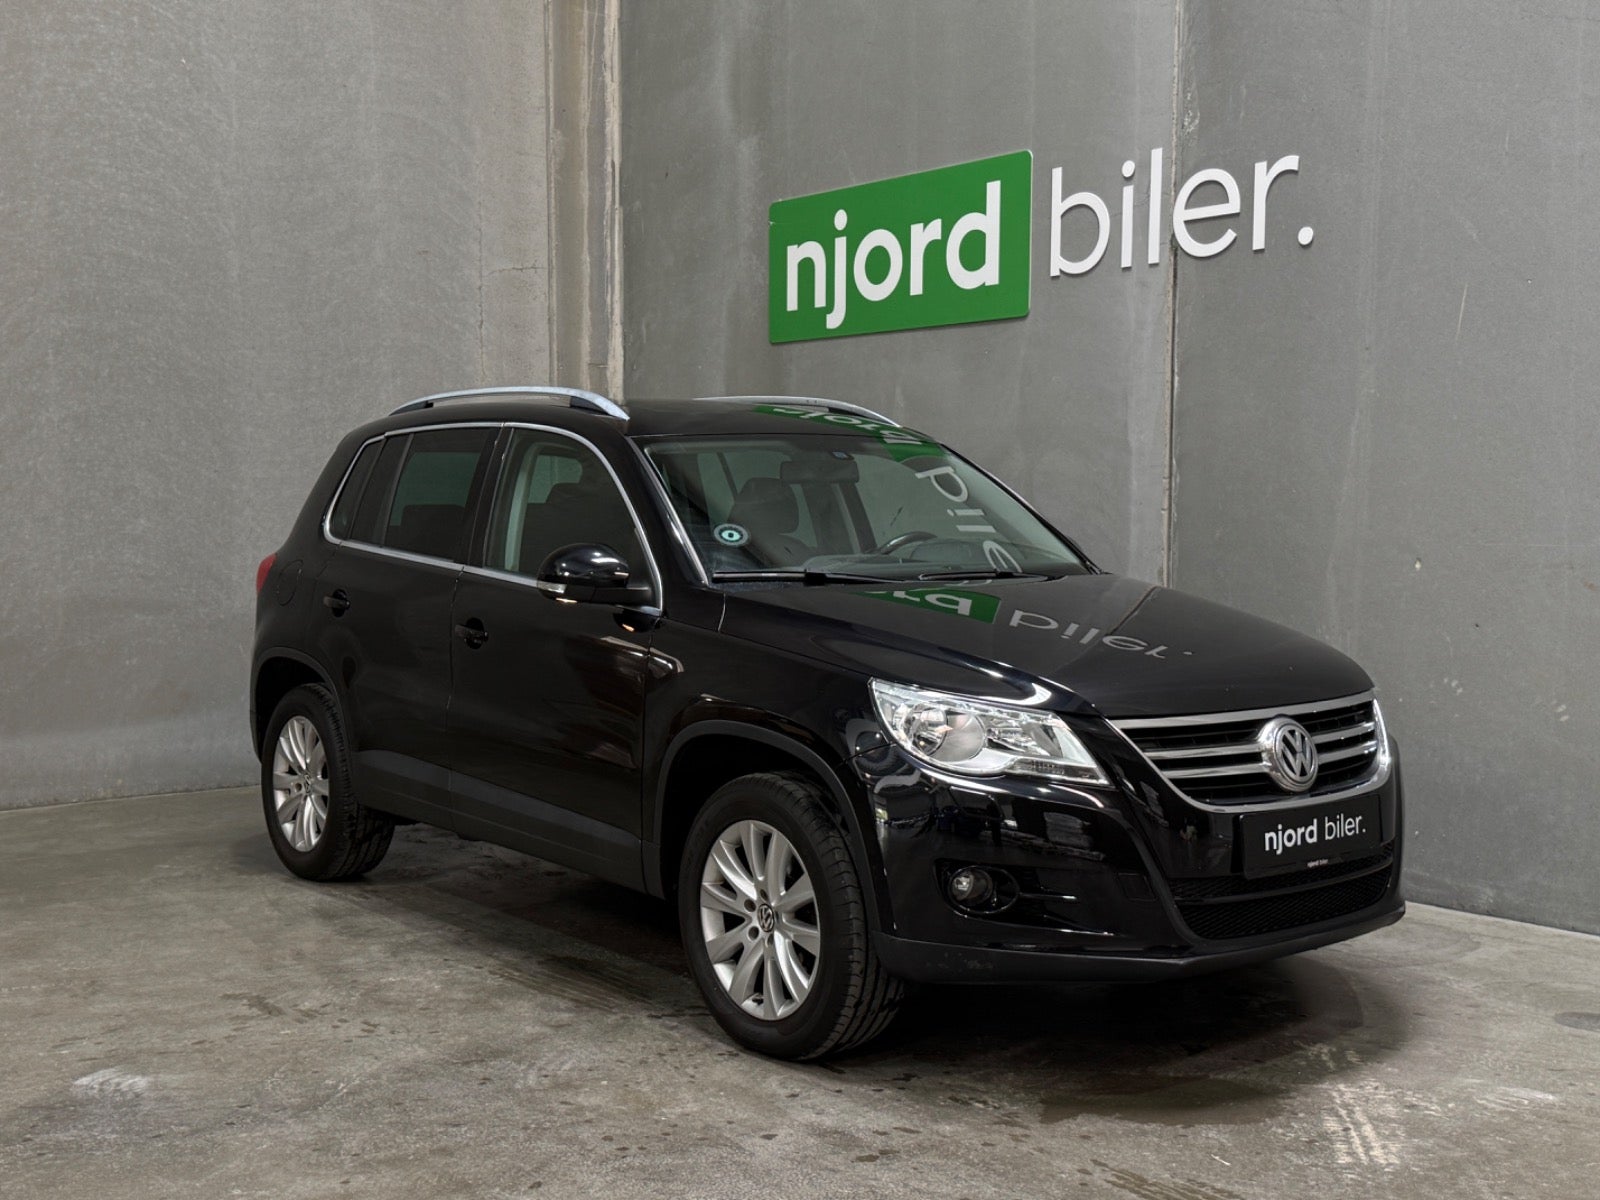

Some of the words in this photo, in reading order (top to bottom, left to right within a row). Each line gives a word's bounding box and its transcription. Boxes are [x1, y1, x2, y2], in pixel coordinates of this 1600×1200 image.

[786, 180, 1001, 329] njord
[1050, 148, 1314, 277] biler.
[1264, 818, 1318, 855] njord
[1324, 813, 1367, 840] biler.
